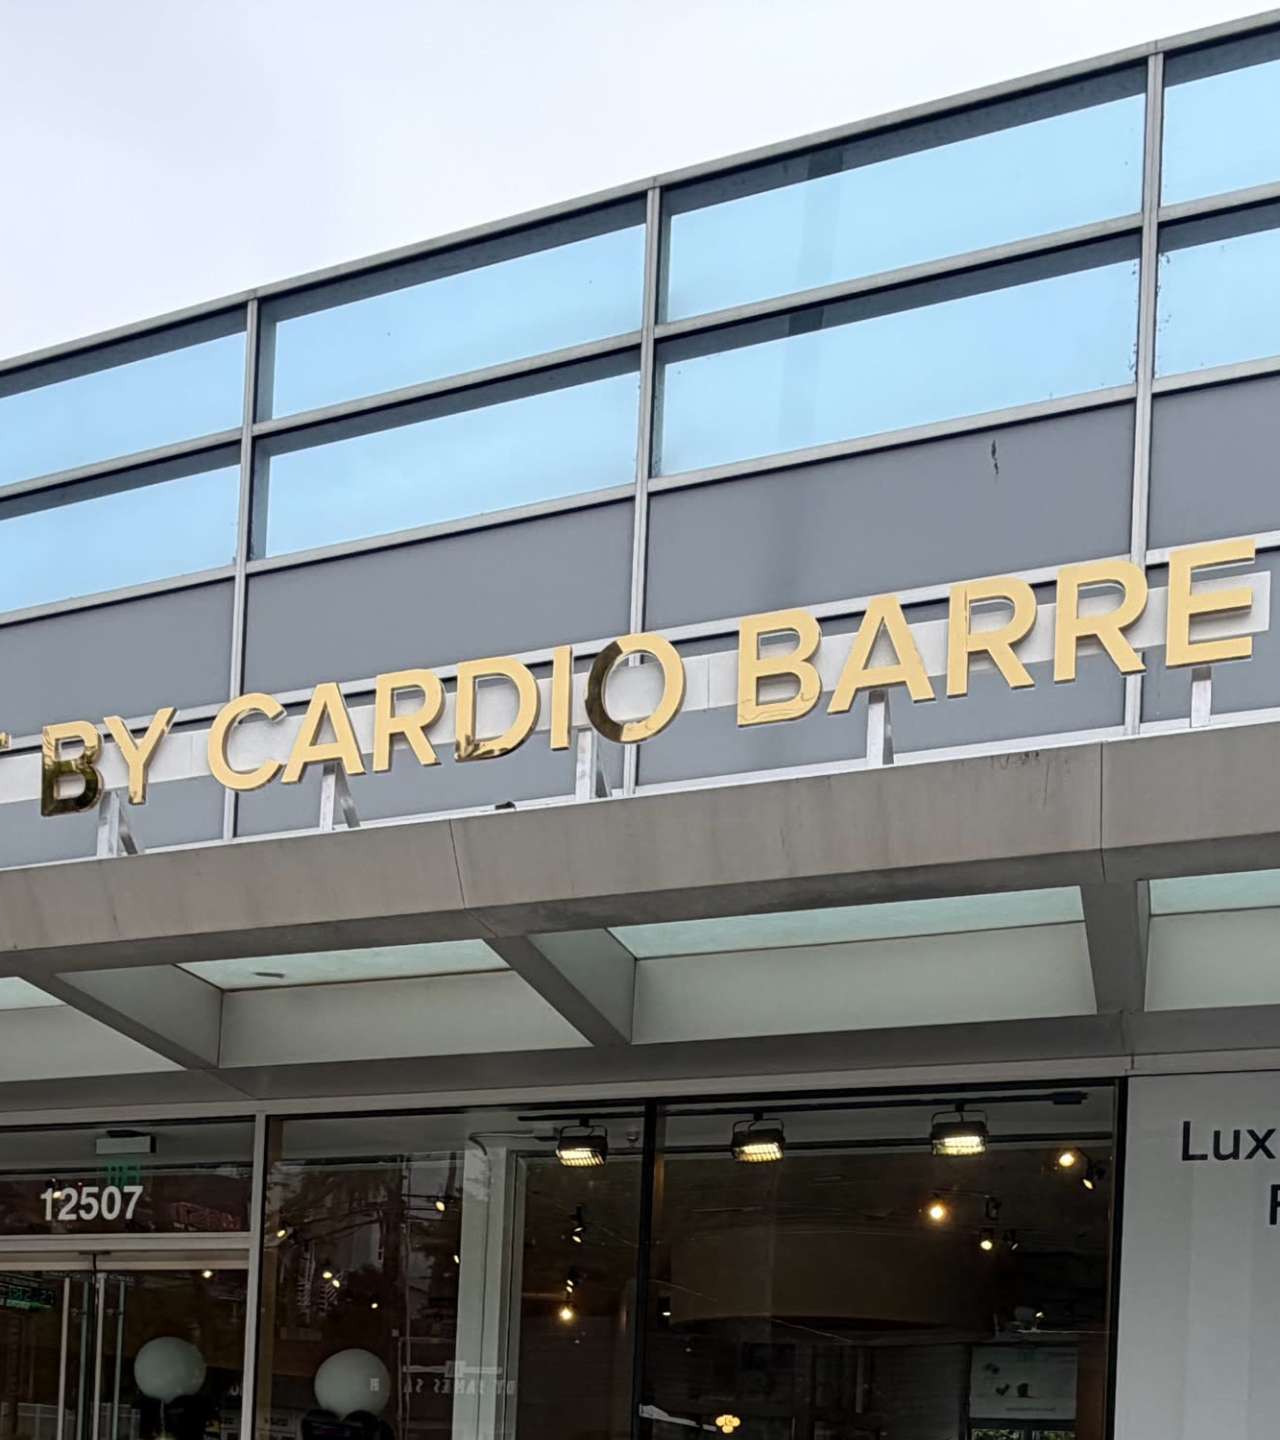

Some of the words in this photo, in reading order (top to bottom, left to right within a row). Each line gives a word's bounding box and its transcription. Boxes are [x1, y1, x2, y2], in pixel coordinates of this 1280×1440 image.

[41, 707, 176, 817] BY
[207, 631, 686, 791] CARDIO
[737, 539, 1255, 727] BARRE
[40, 1186, 144, 1221] 12507
